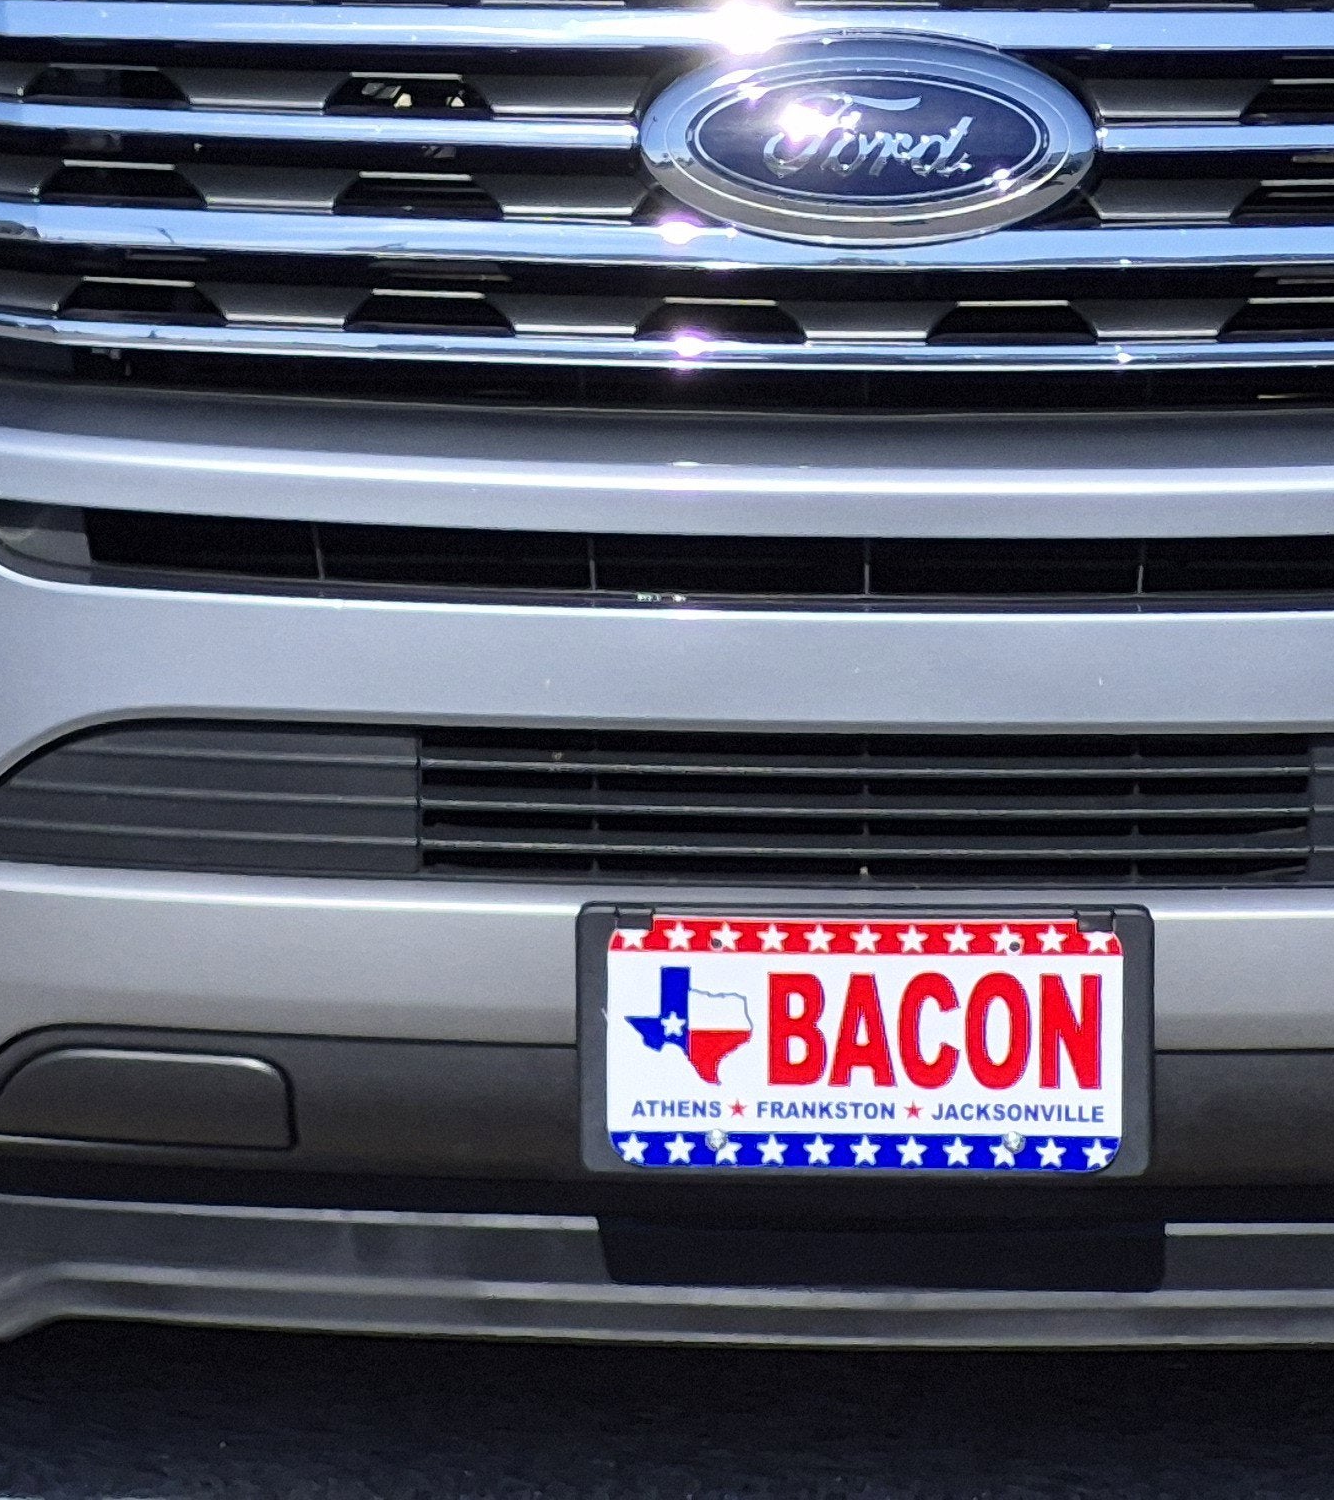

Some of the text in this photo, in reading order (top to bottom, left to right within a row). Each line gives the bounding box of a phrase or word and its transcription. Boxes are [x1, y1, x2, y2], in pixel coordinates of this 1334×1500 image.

[763, 93, 974, 178] Ford
[768, 972, 1102, 1088] BACON
[631, 1099, 1105, 1123] ATHENS FRANKSTON JACKSONVILLE
